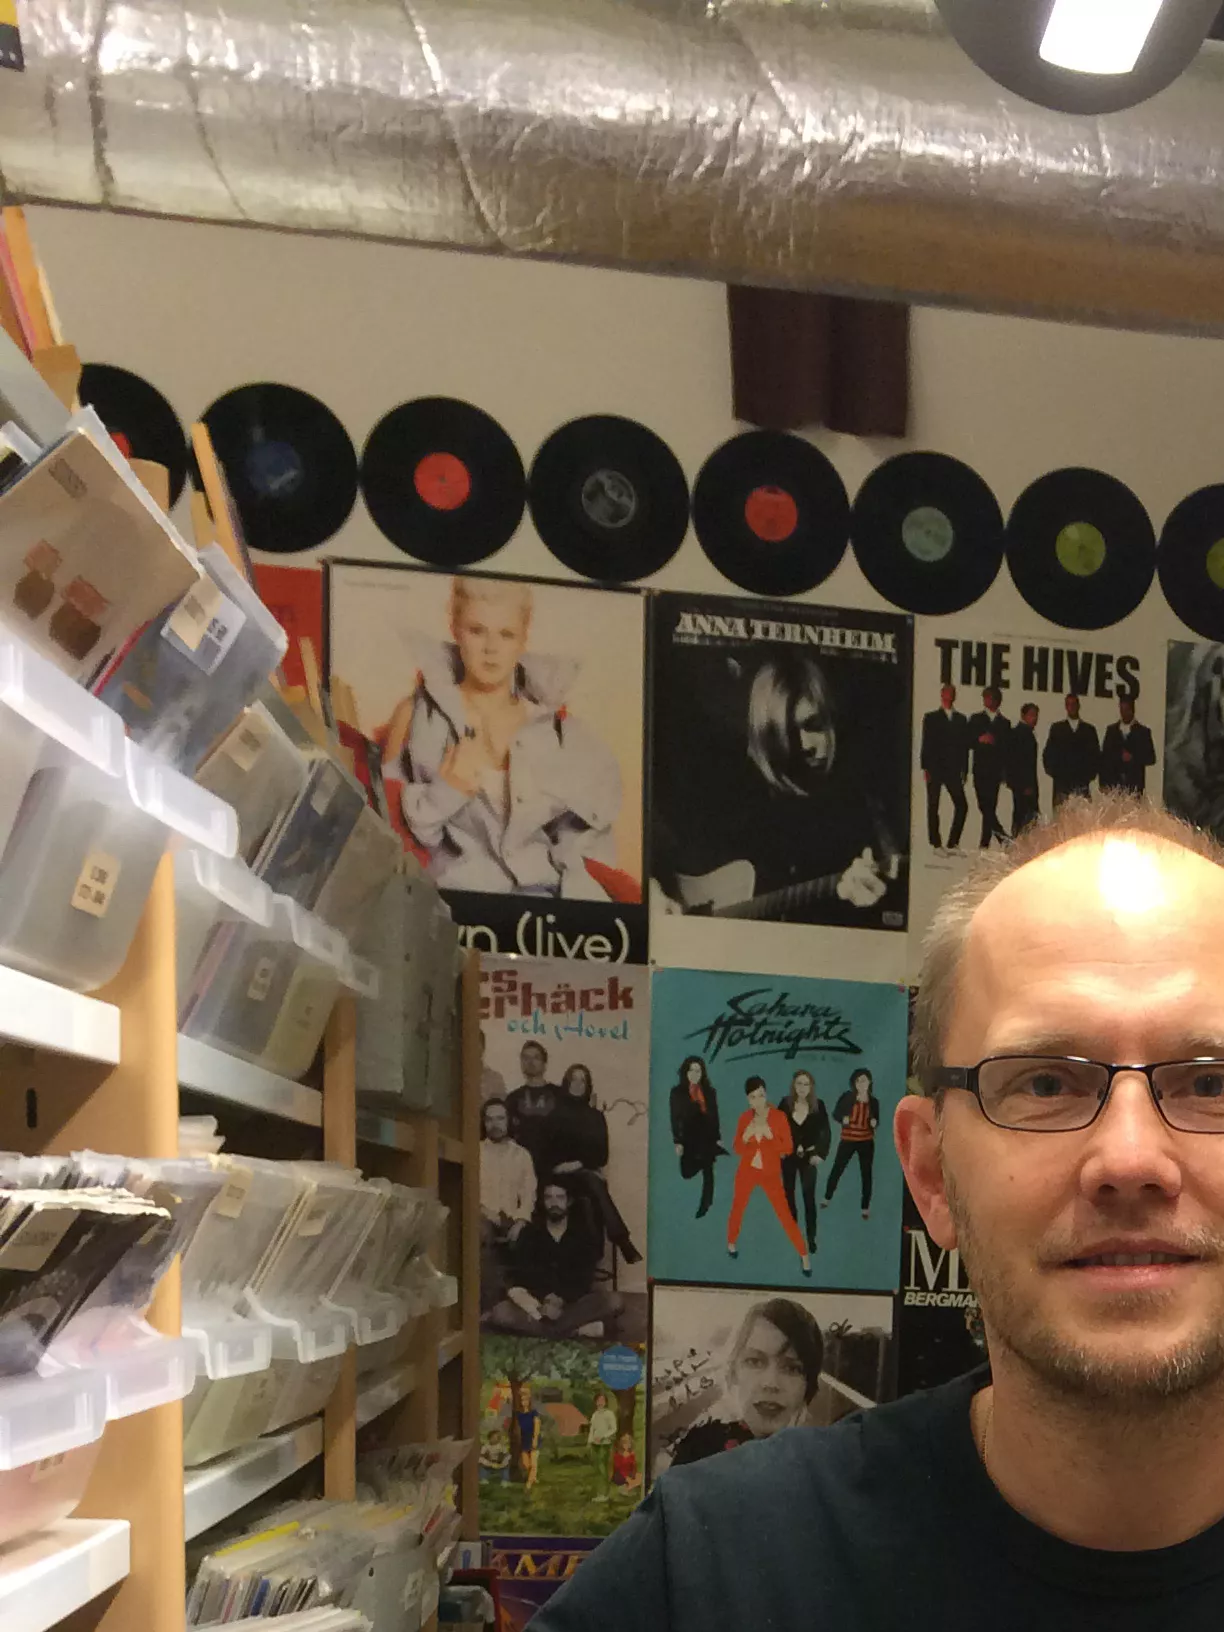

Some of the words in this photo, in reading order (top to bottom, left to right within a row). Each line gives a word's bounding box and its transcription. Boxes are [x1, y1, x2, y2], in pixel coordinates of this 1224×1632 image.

[675, 611, 749, 639] ANNA
[750, 618, 896, 653] TERNHEIM
[934, 637, 1011, 689] THE
[1022, 644, 1140, 701] HIVES
[516, 910, 630, 964] (live)
[507, 1008, 546, 1035] och
[726, 988, 842, 1018] Sahara
[683, 1011, 863, 1064] Hotnights
